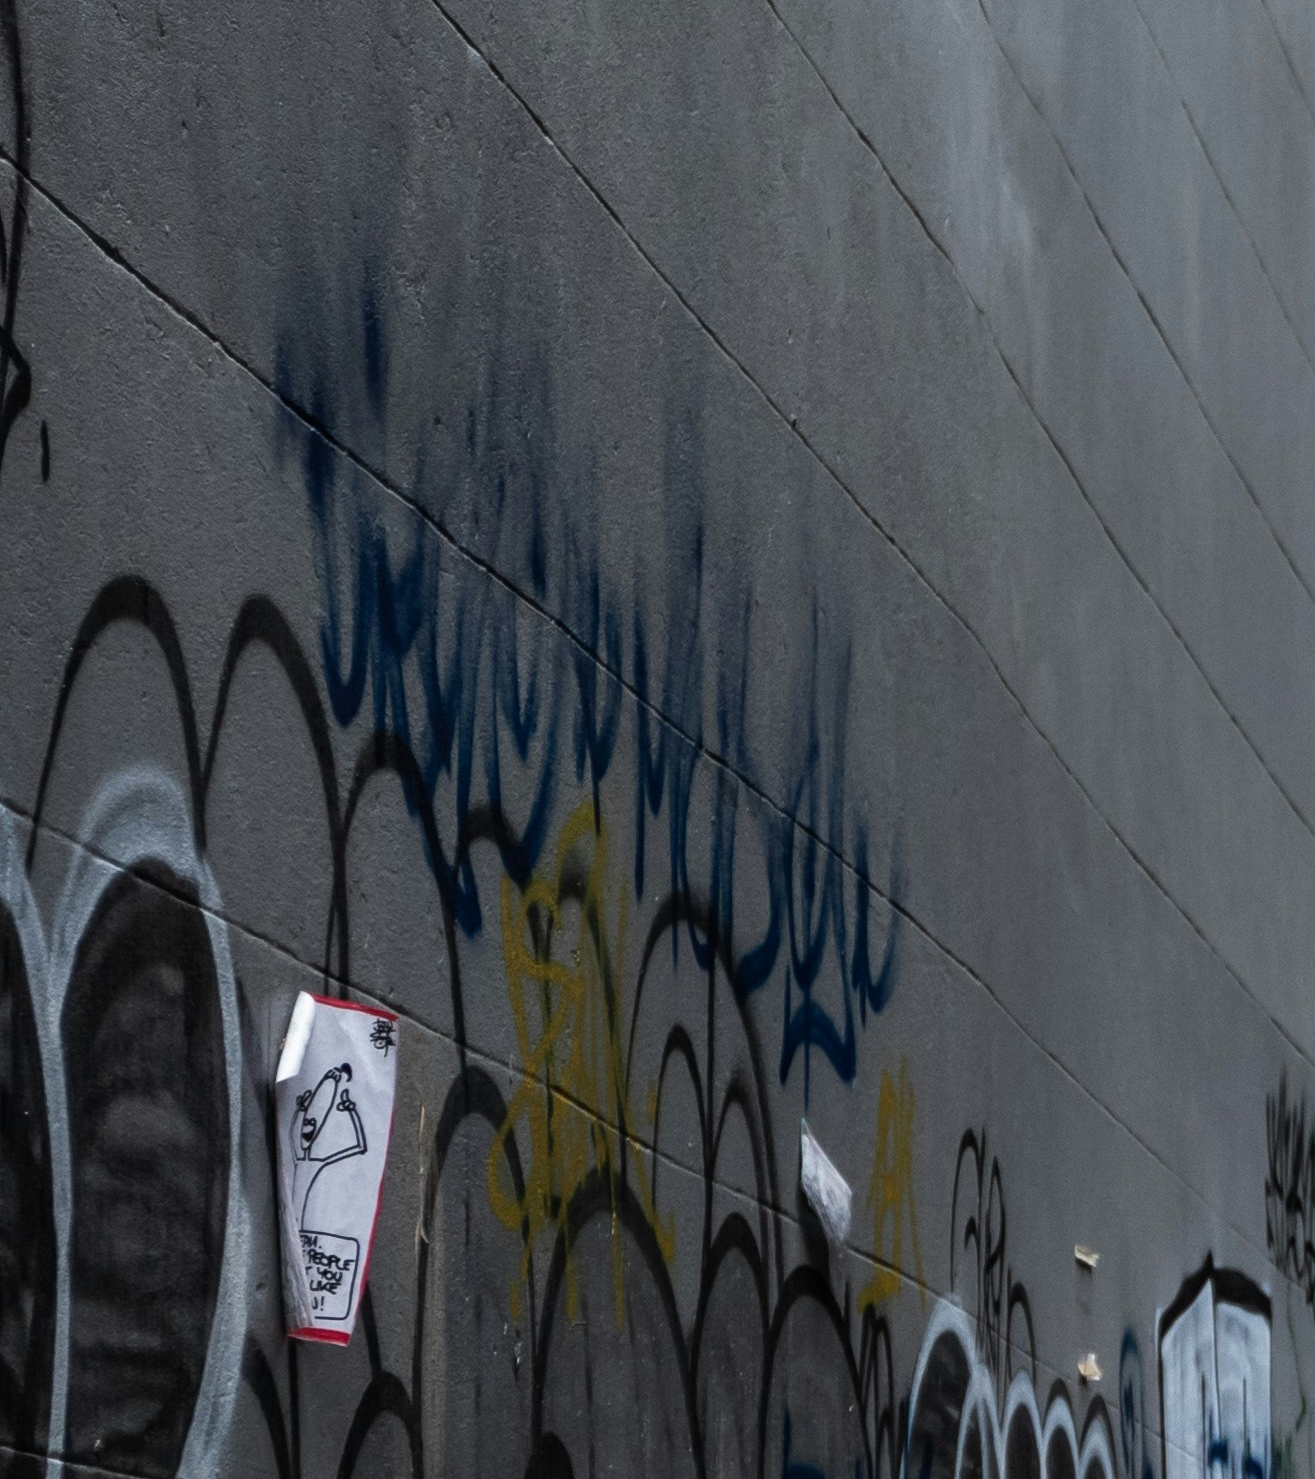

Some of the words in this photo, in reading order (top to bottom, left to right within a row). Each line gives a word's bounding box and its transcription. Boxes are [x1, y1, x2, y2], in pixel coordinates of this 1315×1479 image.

[307, 1249, 355, 1271] PEOPLE
[317, 1267, 343, 1282] YOU
[310, 1280, 341, 1295] LIKE
